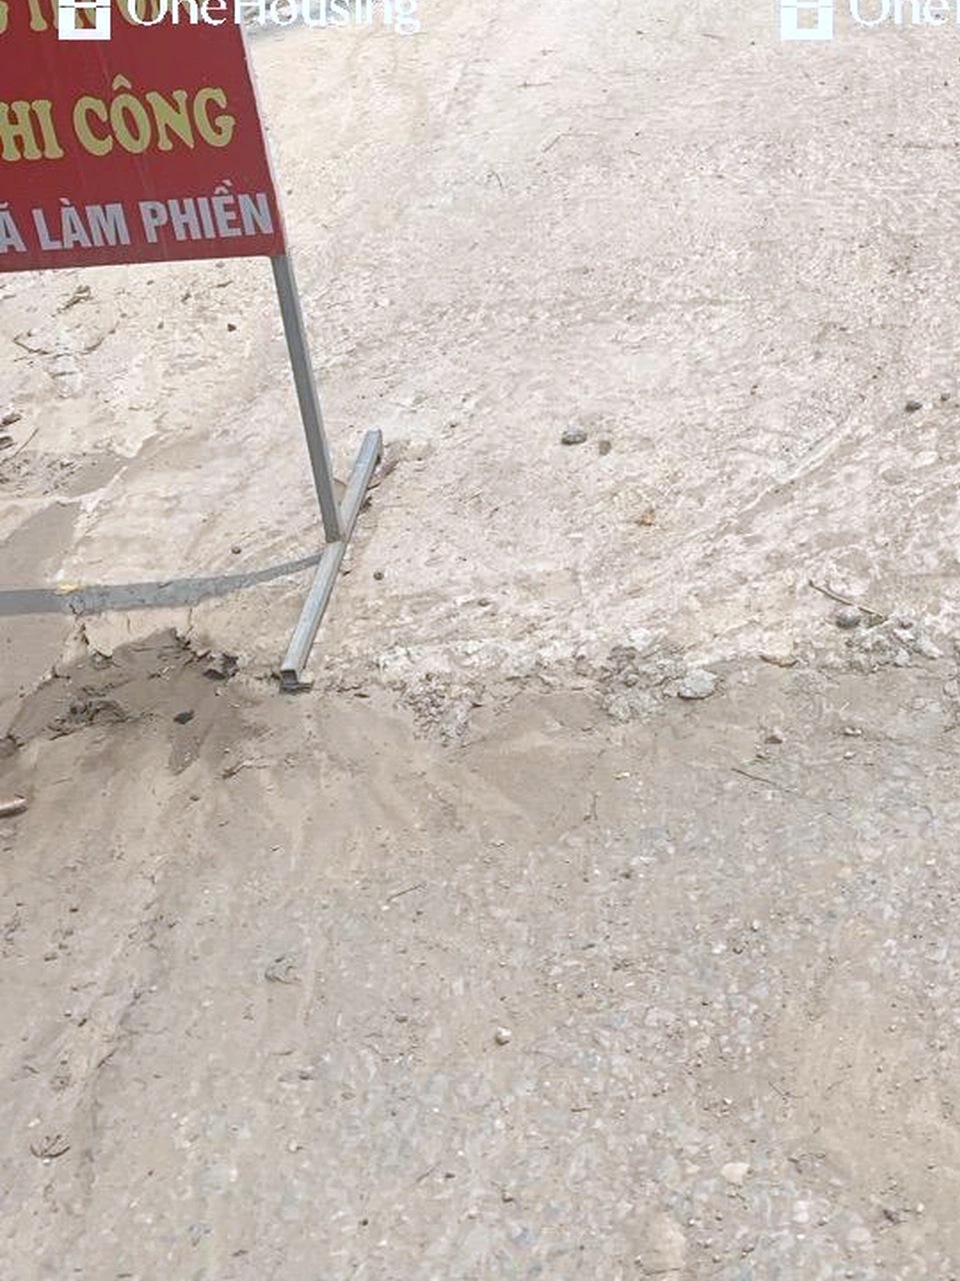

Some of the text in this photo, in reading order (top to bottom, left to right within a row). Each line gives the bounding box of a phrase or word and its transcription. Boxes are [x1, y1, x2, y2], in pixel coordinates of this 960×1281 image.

[72, 74, 236, 157] CÔNG
[31, 197, 131, 251] LÀM
[138, 179, 275, 244] PHIỀN
